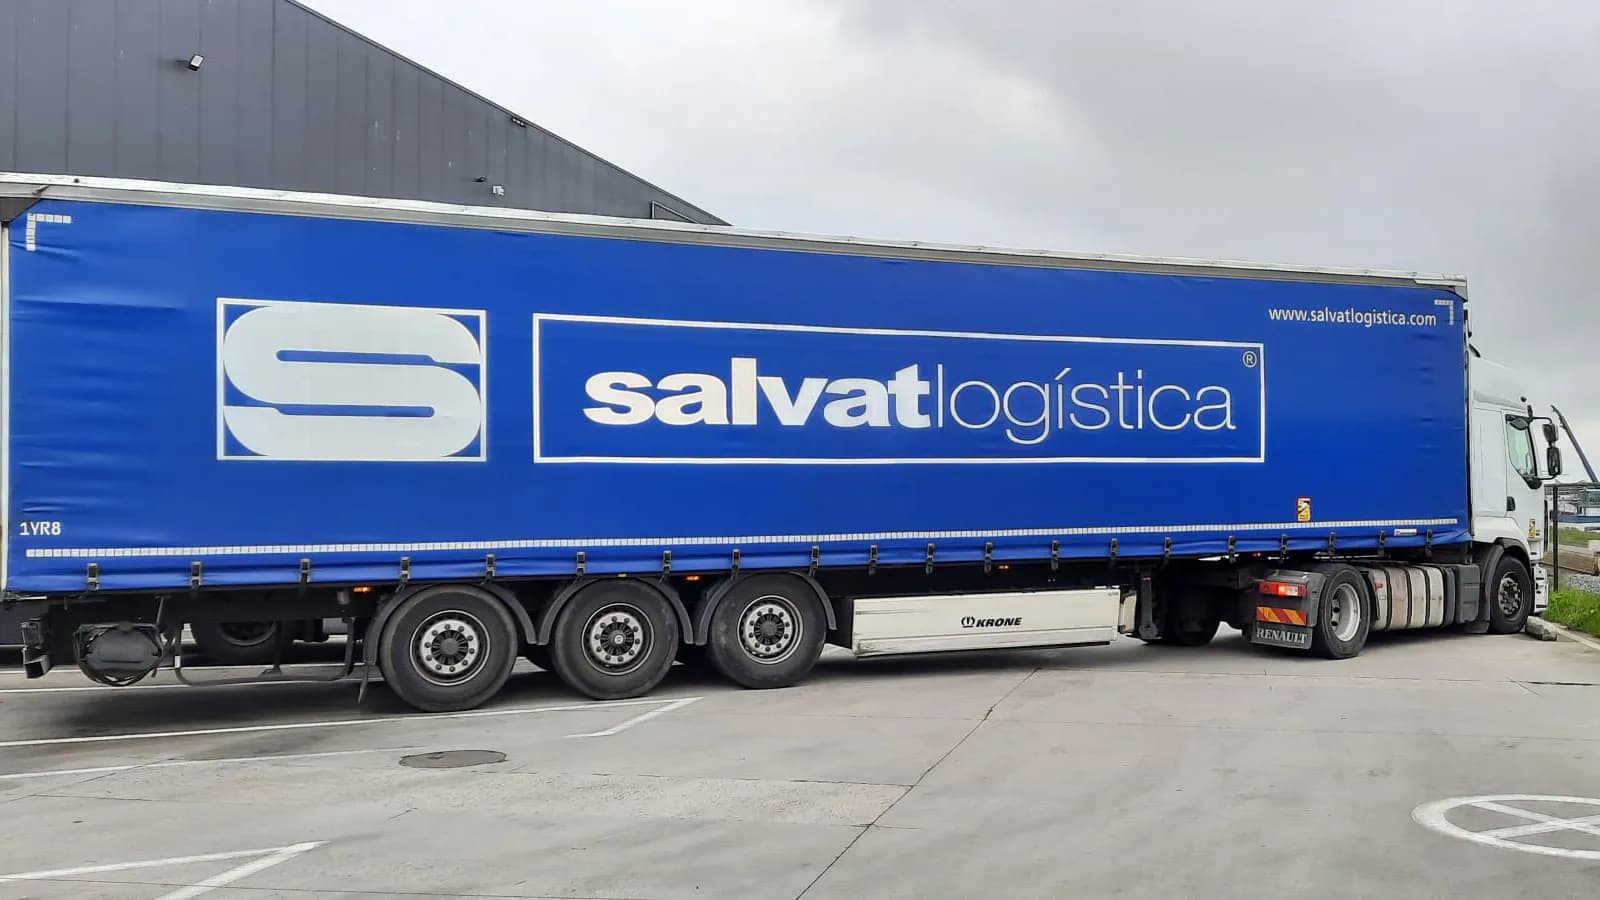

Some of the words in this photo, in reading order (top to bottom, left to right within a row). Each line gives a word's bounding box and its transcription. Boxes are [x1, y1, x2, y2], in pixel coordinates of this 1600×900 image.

[1268, 306, 1437, 328] www.salvatlogistica.com
[19, 521, 62, 536] 1YR8
[975, 617, 1023, 628] KRONE
[1256, 627, 1308, 645] RENAULT
